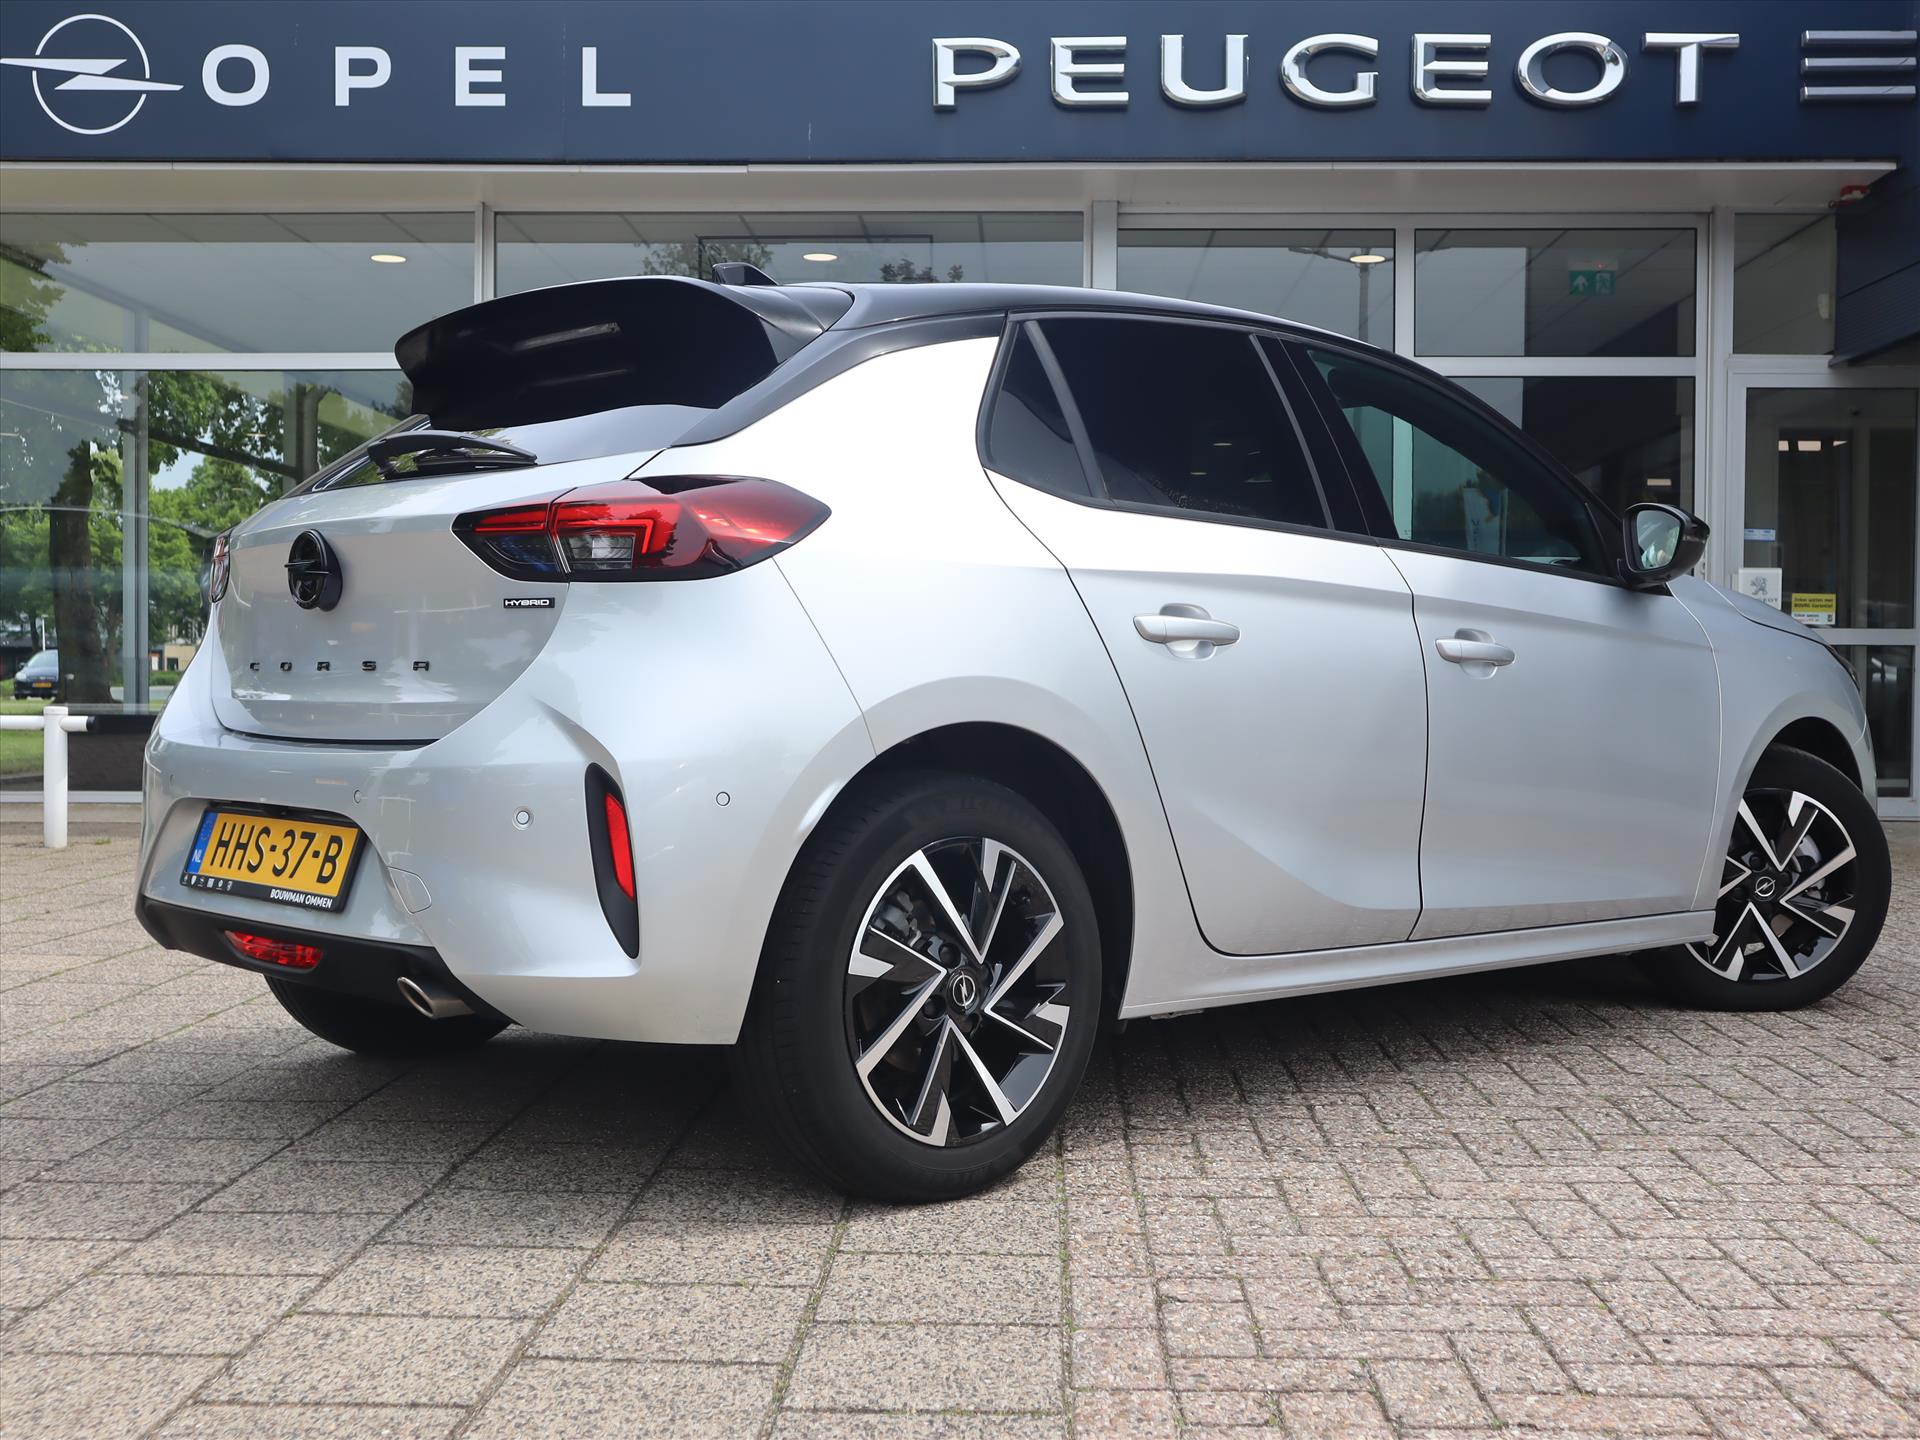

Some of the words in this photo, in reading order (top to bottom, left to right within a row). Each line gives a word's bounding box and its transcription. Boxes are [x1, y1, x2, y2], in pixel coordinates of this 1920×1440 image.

[201, 44, 633, 107] OPEL
[932, 32, 1741, 110] PEUGEOT
[249, 660, 430, 672] CORSA
[192, 849, 202, 862] NL
[210, 821, 344, 884] HHS-37-B
[270, 888, 306, 904] BOUWMAN
[305, 894, 333, 909] OMMEN
